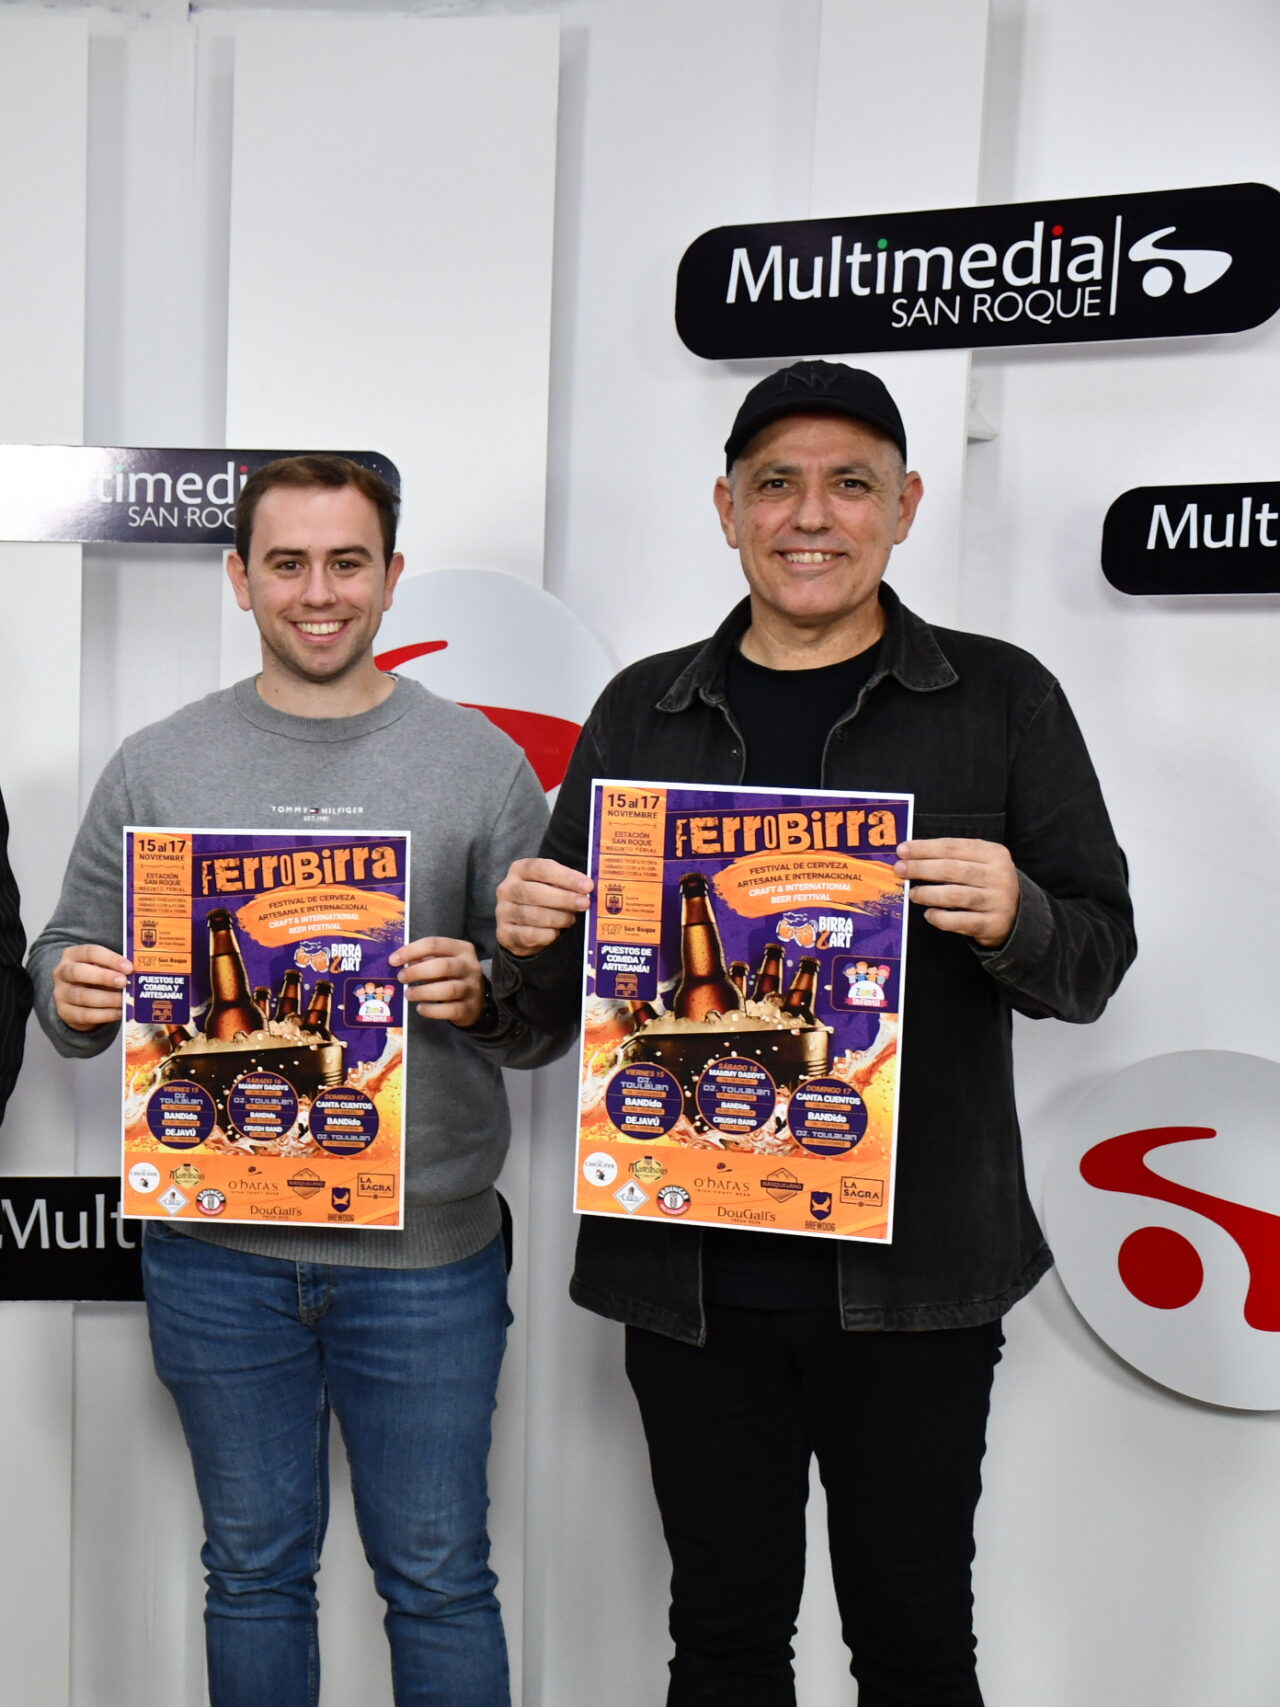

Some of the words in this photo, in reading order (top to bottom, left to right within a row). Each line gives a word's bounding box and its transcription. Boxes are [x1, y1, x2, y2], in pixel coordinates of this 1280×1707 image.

[726, 221, 1104, 304] Multimedia
[891, 297, 960, 328] SAN
[972, 287, 1101, 326] ROQUE
[128, 506, 179, 528] SAN
[607, 793, 626, 808] 15
[628, 797, 638, 808] al
[640, 794, 659, 809] 17
[271, 805, 308, 814] TOMMY
[321, 806, 364, 815] HILFIGER
[607, 809, 658, 819] NOVIEMBRE
[614, 830, 649, 839] ESTACIÓN
[138, 838, 155, 852] 15
[157, 842, 166, 852] al
[169, 839, 186, 852] 17
[627, 838, 652, 846] ROQUE
[139, 853, 185, 861] NOVIEMBRE
[749, 864, 790, 874] FESTIVAL
[737, 877, 783, 888] ARTESANA
[792, 871, 863, 882] INTERNACIONAL
[748, 886, 775, 897] CRAFT
[785, 884, 852, 892] INTERNATIONAL
[268, 897, 304, 909] FESTIVAL
[771, 894, 792, 903] BEER
[793, 893, 831, 902] FESTIVAL
[258, 910, 299, 921] ARTESANA
[306, 904, 369, 912] INTERNACIONAL
[268, 918, 292, 928] CRAFT
[300, 913, 359, 923] INTERNATIONAL
[818, 915, 853, 934] BIRRA
[288, 925, 307, 934] BEER
[307, 923, 341, 932] FESTIVAL
[828, 932, 851, 949] ART
[331, 943, 361, 958] BIRRA
[640, 948, 652, 956] DE
[606, 953, 639, 964] COMIDA
[638, 956, 646, 964] Y
[340, 957, 360, 972] ART
[143, 983, 173, 991] COMIDA
[625, 1068, 654, 1077] VIERNES
[708, 1068, 737, 1077] MAMMY
[805, 1085, 841, 1094] DOMINGO
[315, 1100, 339, 1108] CANTA
[624, 1096, 662, 1108] BANDido
[795, 1092, 823, 1102] CANTA
[823, 1095, 861, 1105] CUENTOS
[163, 1111, 197, 1120] BANDido
[625, 1114, 660, 1126] DEJAVÚ
[712, 1116, 736, 1124] CRUSH
[737, 1118, 757, 1126] BAND
[807, 1111, 847, 1123] BANDido
[326, 1117, 361, 1126] BANDido
[165, 1126, 196, 1136] DEJAVÚ
[843, 1181, 857, 1189] LA
[843, 1189, 879, 1199] SAGRA
